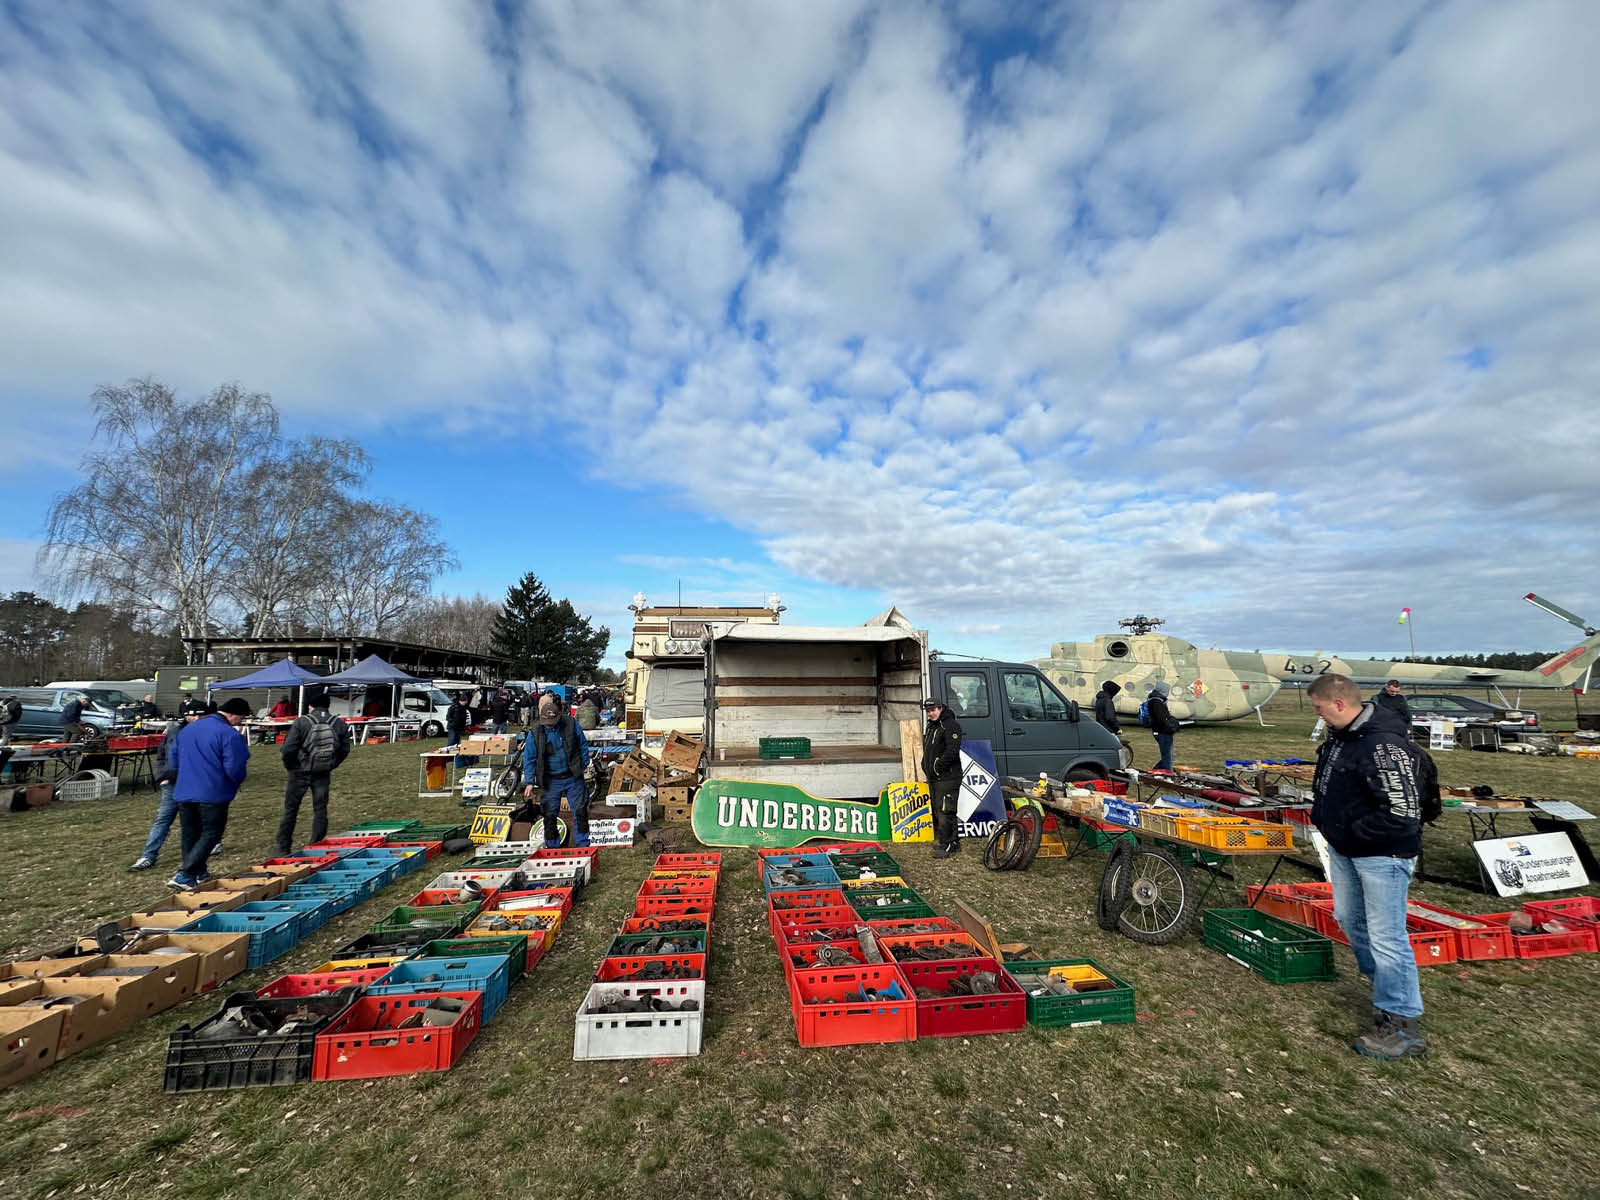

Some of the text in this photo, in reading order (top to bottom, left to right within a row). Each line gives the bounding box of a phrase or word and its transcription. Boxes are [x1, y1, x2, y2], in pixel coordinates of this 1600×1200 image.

[966, 775, 988, 785] IFA
[1388, 770, 1404, 789] CAMP
[890, 784, 918, 808] Fahrt
[717, 796, 877, 834] UNDERBERG
[891, 794, 929, 825] DUNLOP
[472, 817, 506, 835] DKW
[901, 819, 932, 840] Reifen
